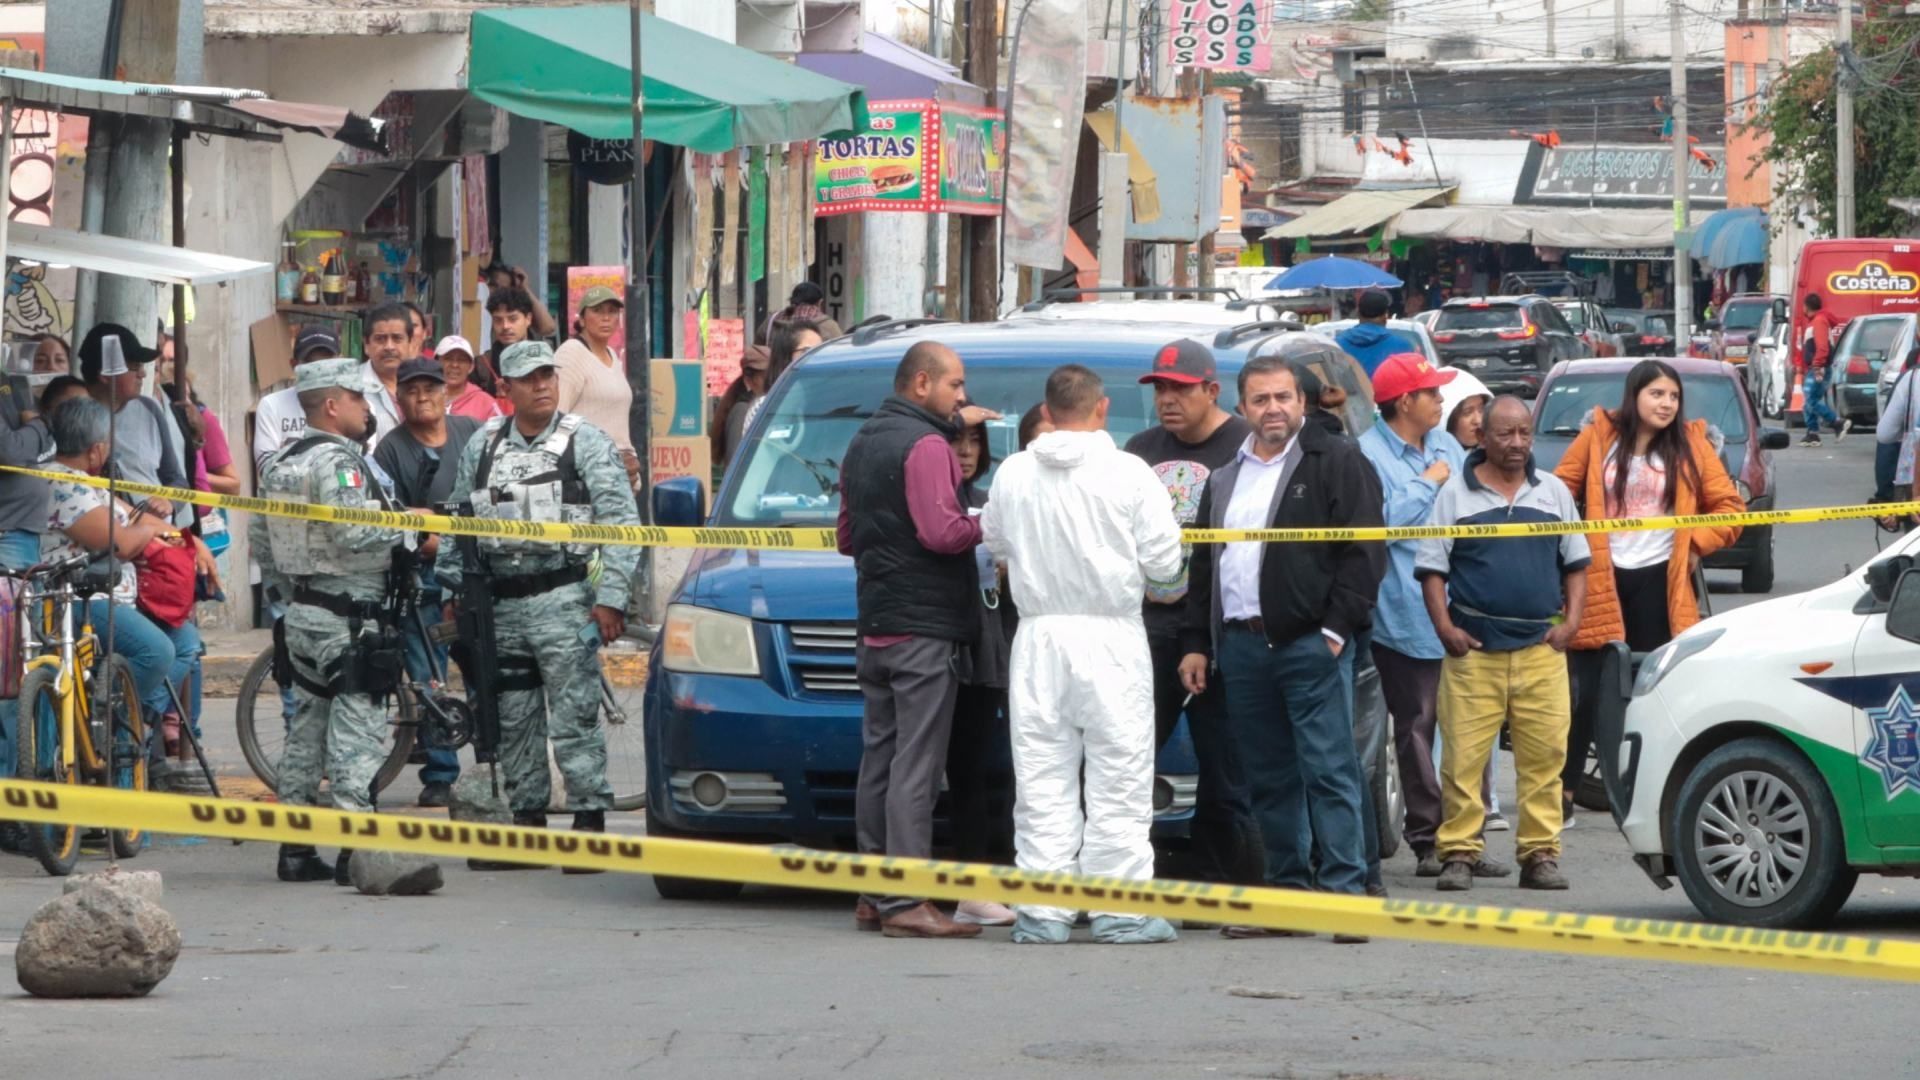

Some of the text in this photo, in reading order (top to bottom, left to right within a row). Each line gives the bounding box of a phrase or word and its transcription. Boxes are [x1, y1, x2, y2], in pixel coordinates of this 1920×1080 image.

[1174, 0, 1197, 63] ITOS
[871, 117, 896, 130] as
[817, 135, 916, 161] TORTAS
[1865, 265, 1882, 277] La
[1835, 275, 1911, 290] Costeña
